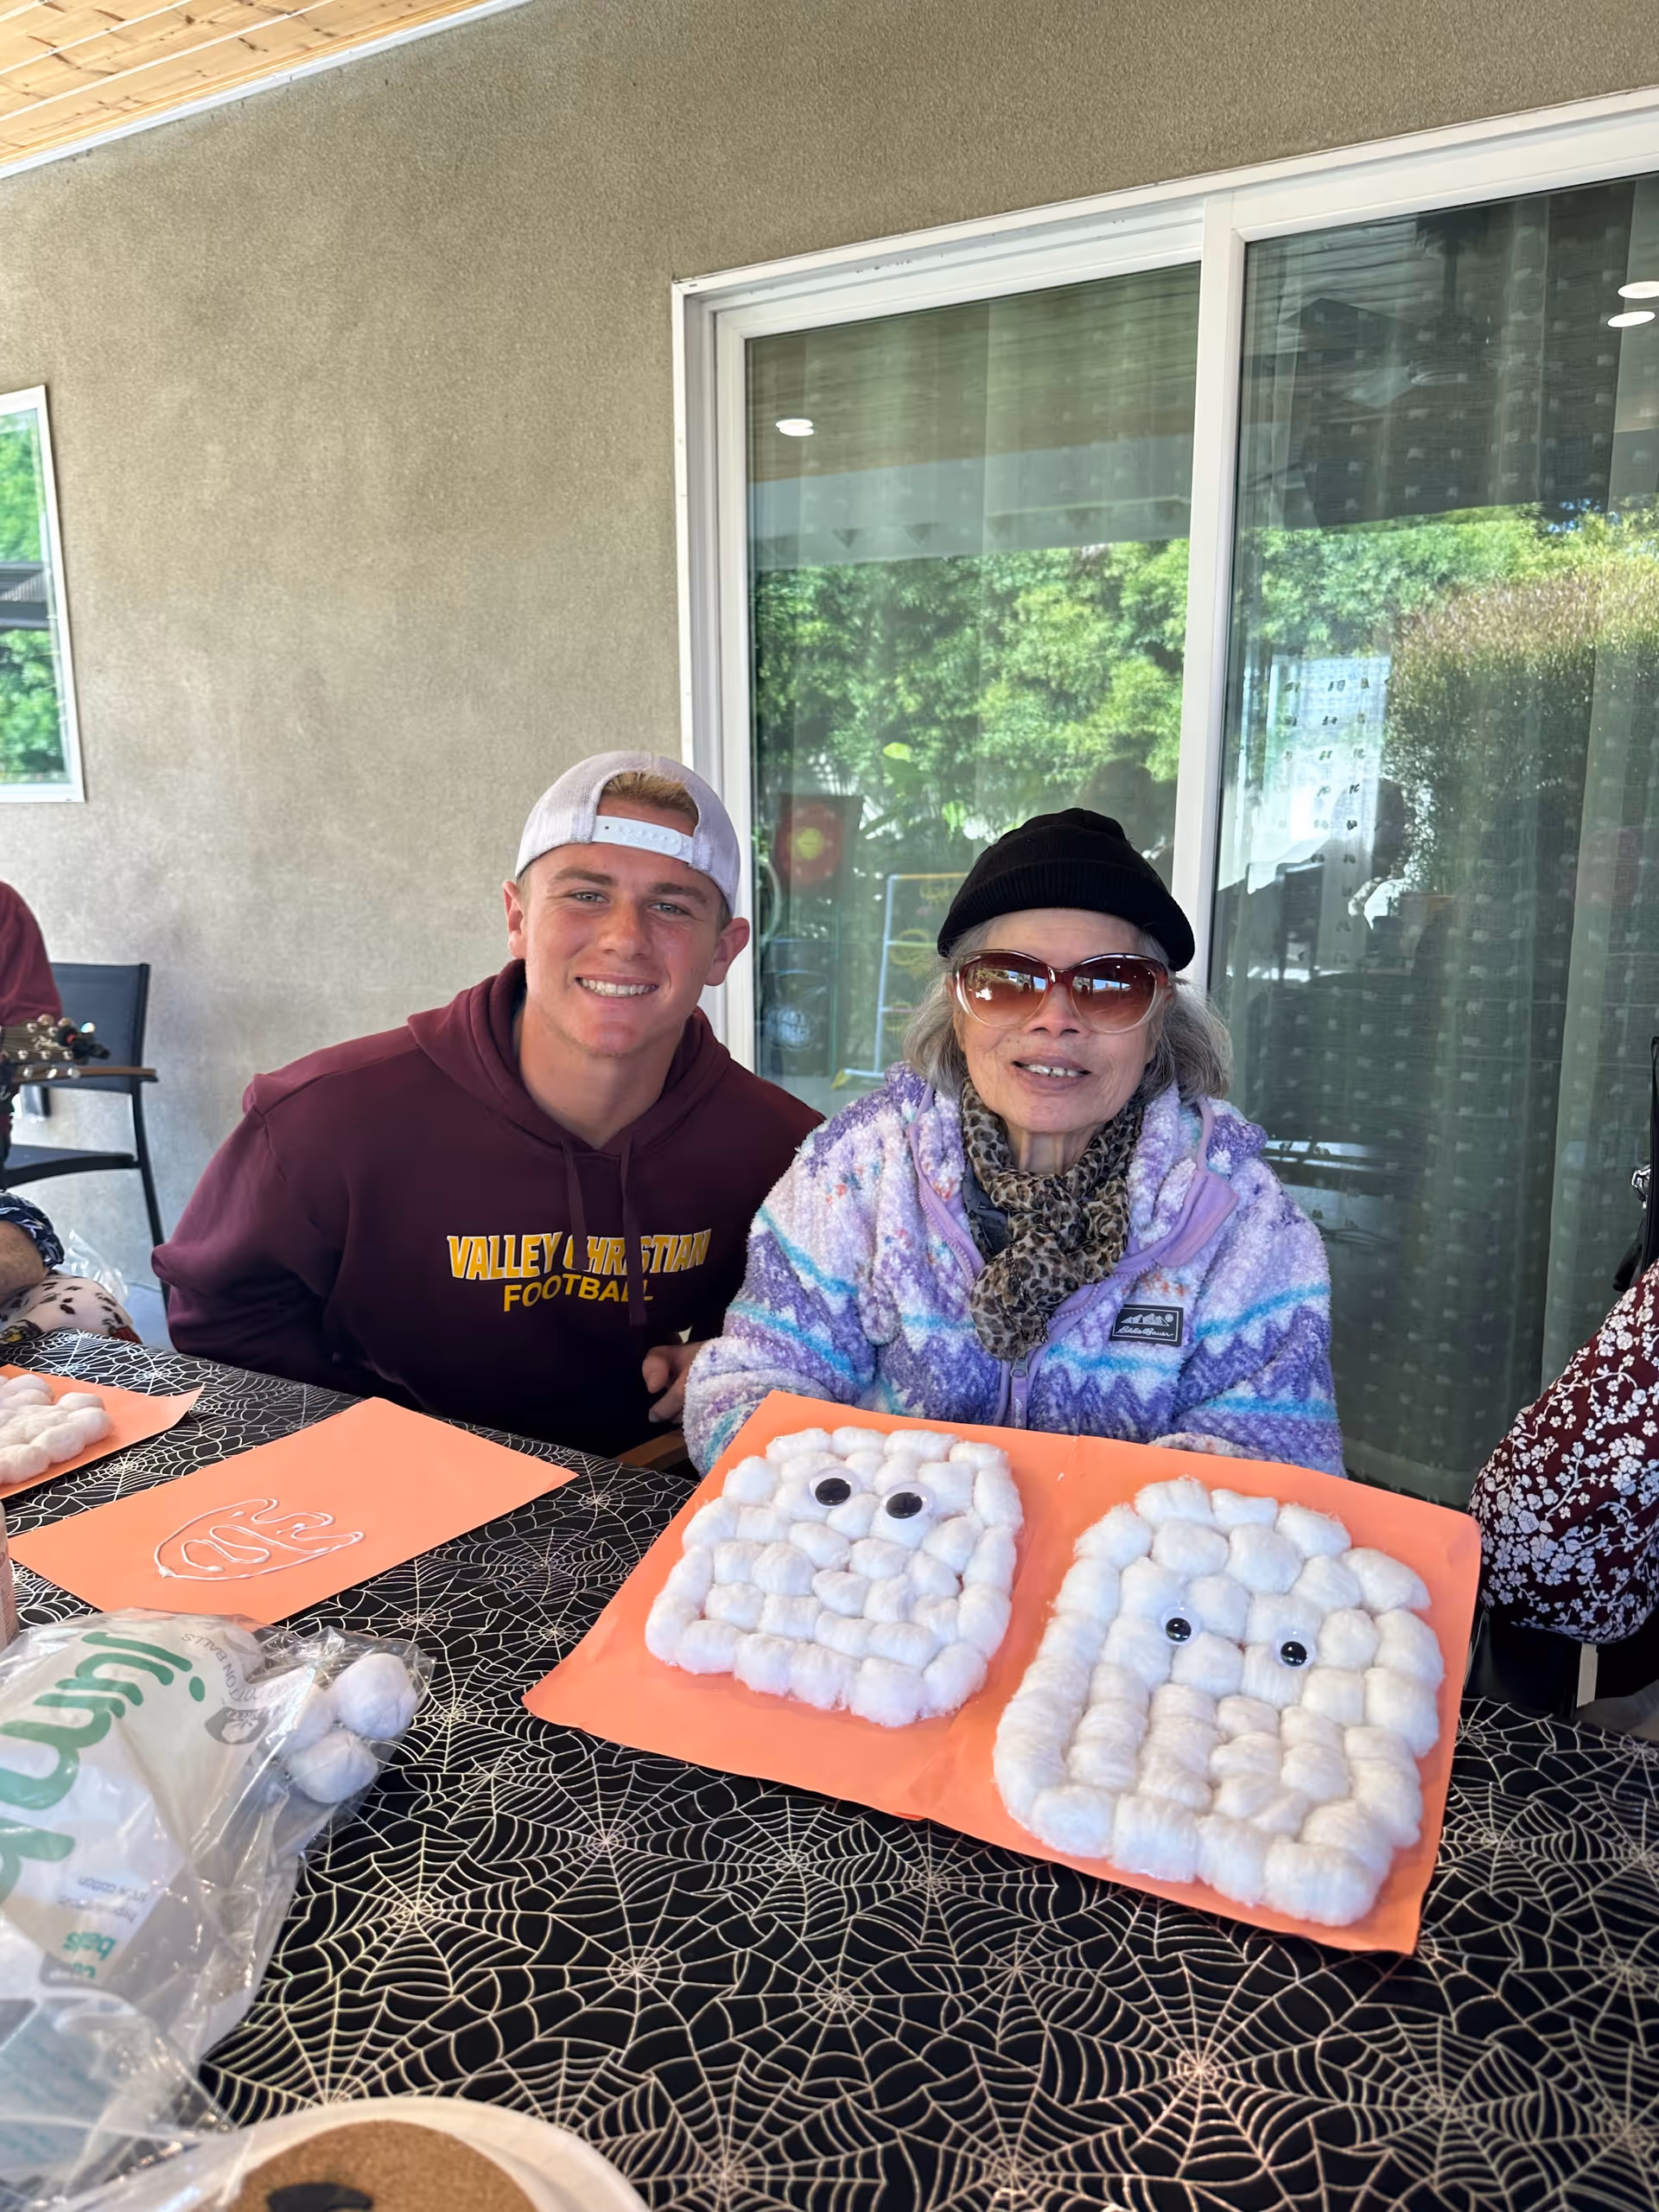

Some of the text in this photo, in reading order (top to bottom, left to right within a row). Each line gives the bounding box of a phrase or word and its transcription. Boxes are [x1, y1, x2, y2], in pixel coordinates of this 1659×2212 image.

[447, 1231, 563, 1281] VALLEY
[181, 1633, 227, 1662] BALLS
[223, 1663, 257, 1702] OTTON
